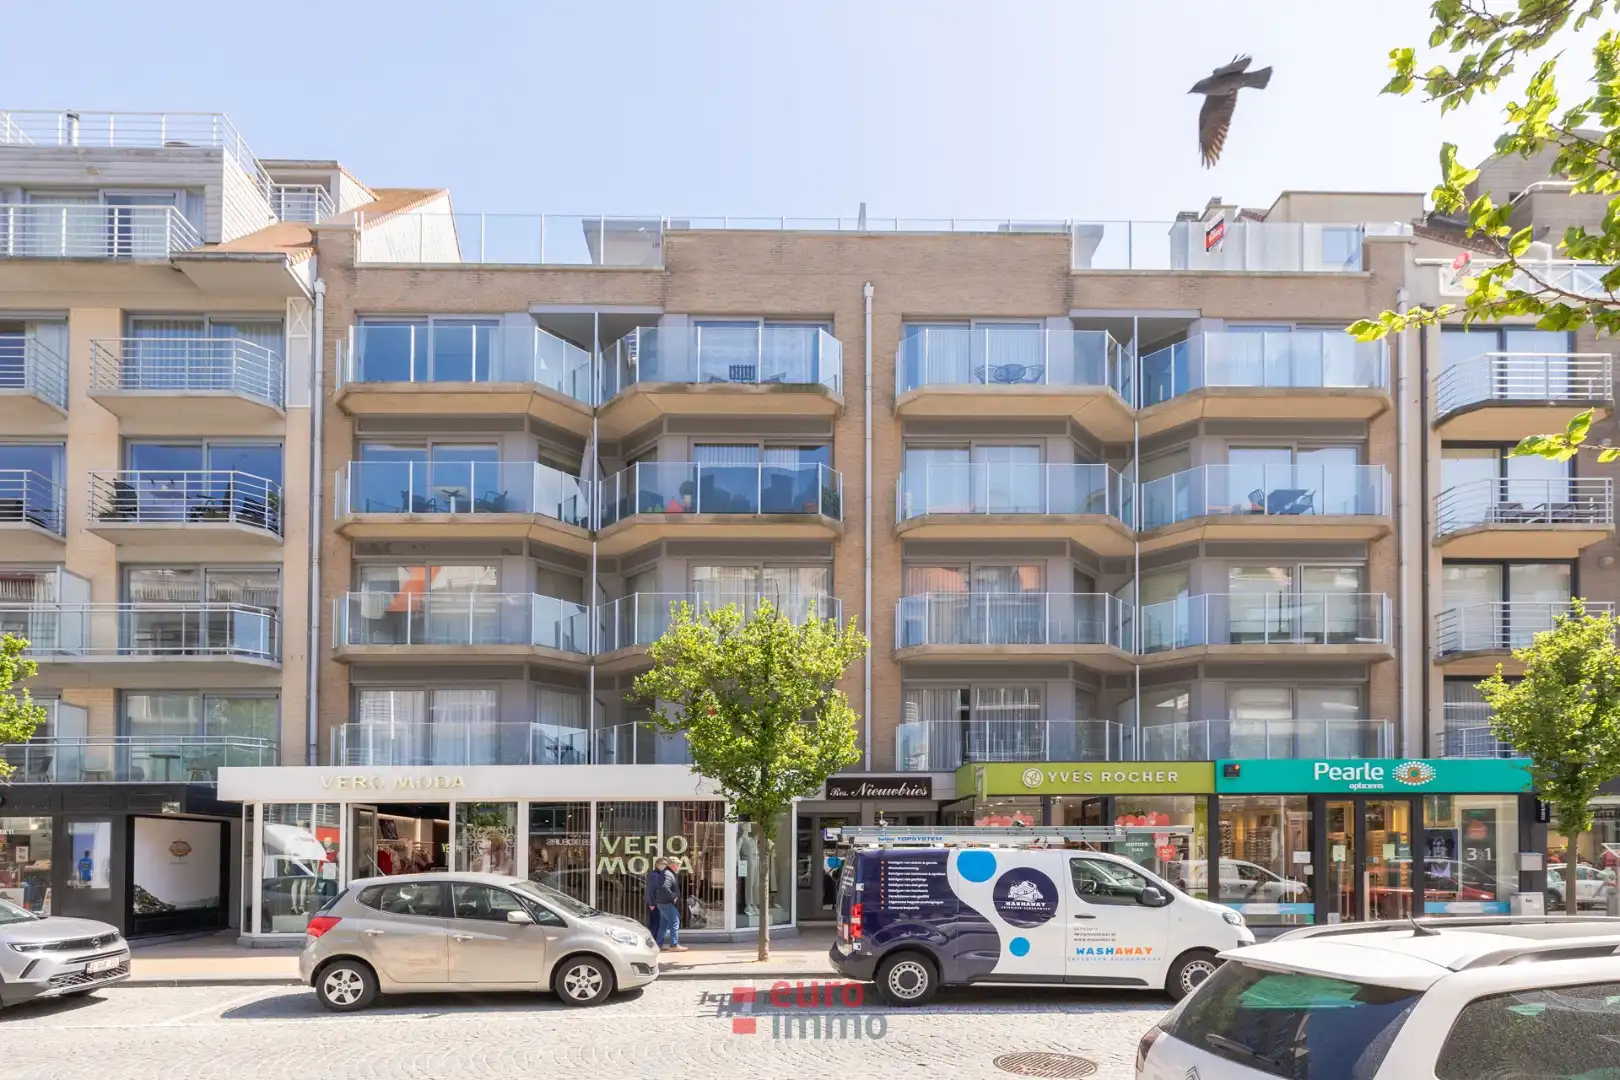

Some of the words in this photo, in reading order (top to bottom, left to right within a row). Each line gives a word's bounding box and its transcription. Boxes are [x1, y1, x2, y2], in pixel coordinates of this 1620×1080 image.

[1047, 771, 1093, 783] YVES
[1101, 771, 1179, 783] ROCHER
[1314, 762, 1384, 780] Pearle
[319, 775, 386, 790] VERO
[392, 775, 466, 790] MODA
[829, 787, 849, 797] Res.
[851, 782, 928, 796] Nieuwbries
[596, 856, 693, 874] MOA
[1076, 947, 1153, 956] WASHAWAY
